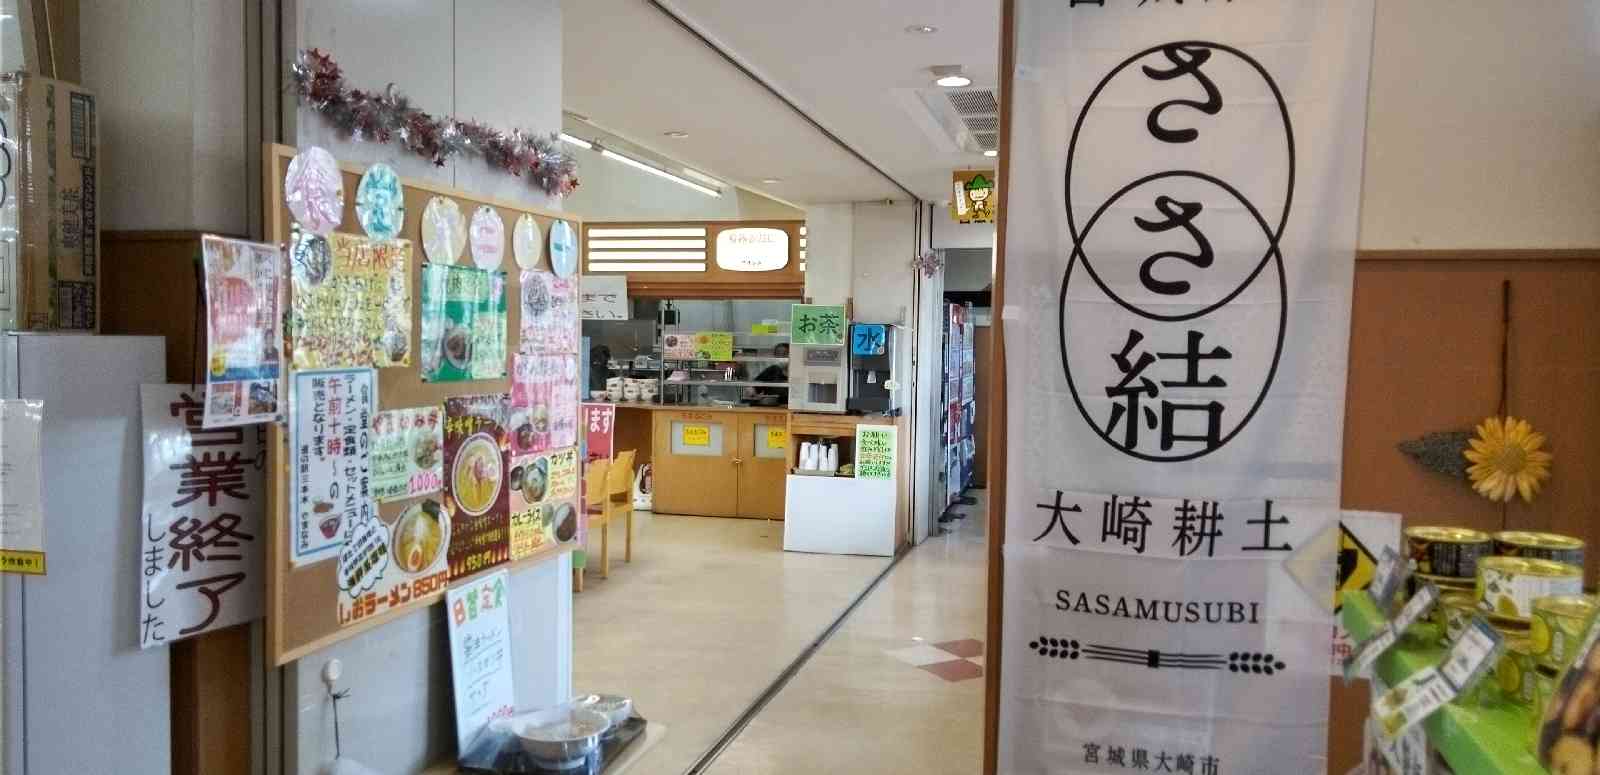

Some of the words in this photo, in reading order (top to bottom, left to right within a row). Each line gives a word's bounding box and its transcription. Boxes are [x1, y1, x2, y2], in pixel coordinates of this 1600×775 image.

[1105, 46, 1233, 451] ささ結
[800, 313, 842, 335] お茶
[857, 329, 880, 350] 水
[1033, 490, 1293, 557] 大崎耕土
[143, 513, 166, 643] しました
[1056, 590, 1259, 624] SASAMUSUBI
[1082, 743, 1219, 775] 宮城県大崎市
